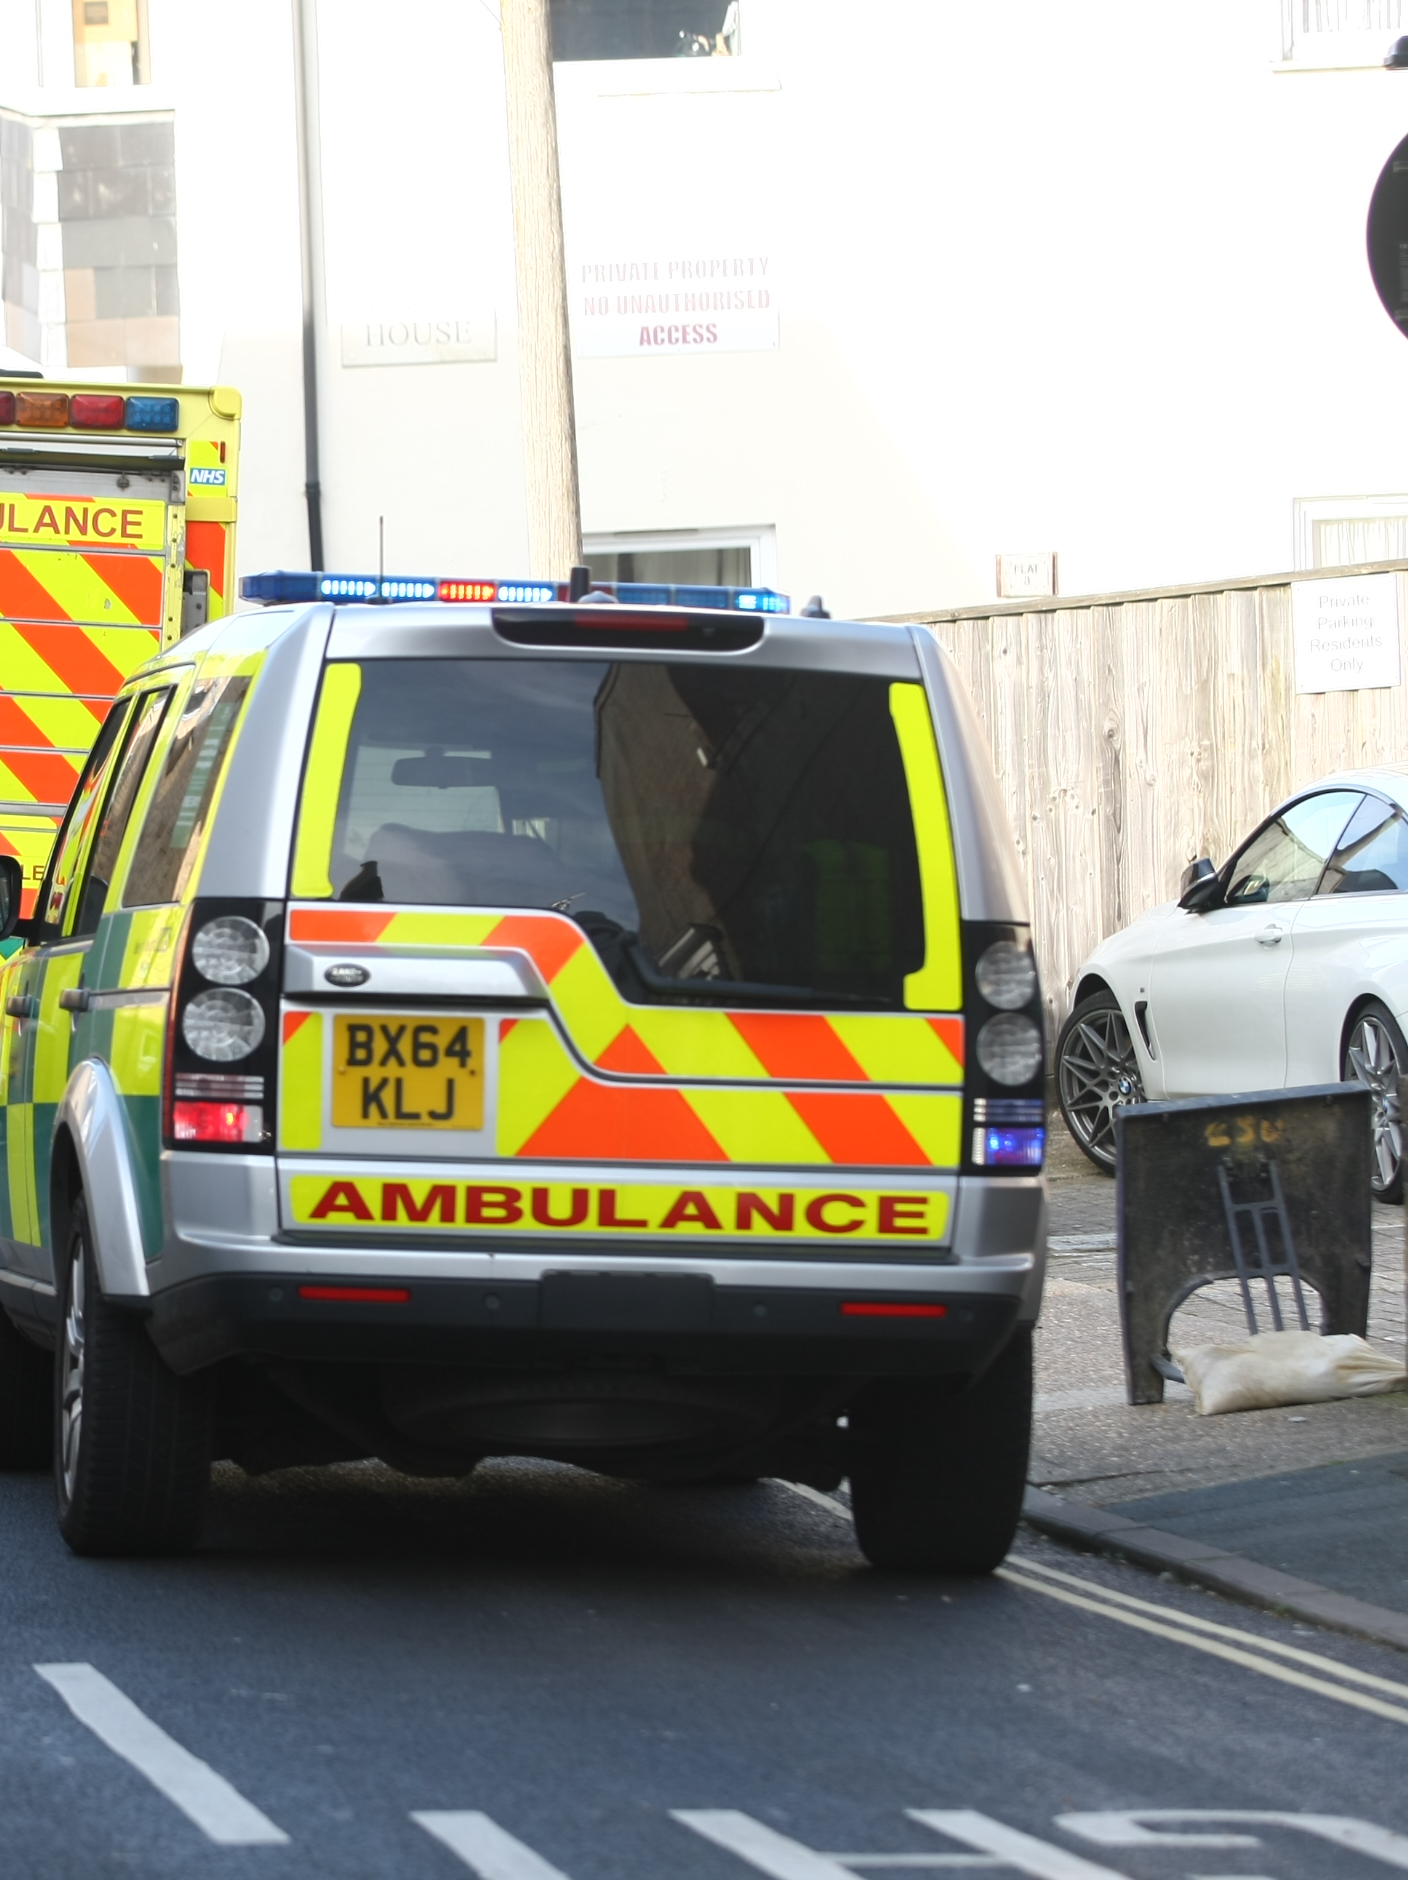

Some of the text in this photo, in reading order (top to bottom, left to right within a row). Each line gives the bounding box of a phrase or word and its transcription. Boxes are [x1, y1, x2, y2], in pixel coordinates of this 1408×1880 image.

[581, 257, 769, 283] PRIVATE PROPERTY
[584, 289, 770, 316] NO UNAUTHORISED
[365, 320, 472, 347] HOUSE
[638, 322, 718, 346] ACCESS
[190, 469, 225, 484] NHS
[1319, 594, 1370, 608] Private
[1317, 615, 1373, 630] Parking
[1310, 635, 1383, 652] Residents
[1330, 657, 1364, 673] Only
[346, 1023, 472, 1068] BX64
[361, 1076, 455, 1121] KLJ
[308, 1181, 930, 1235] AMBULANCE
